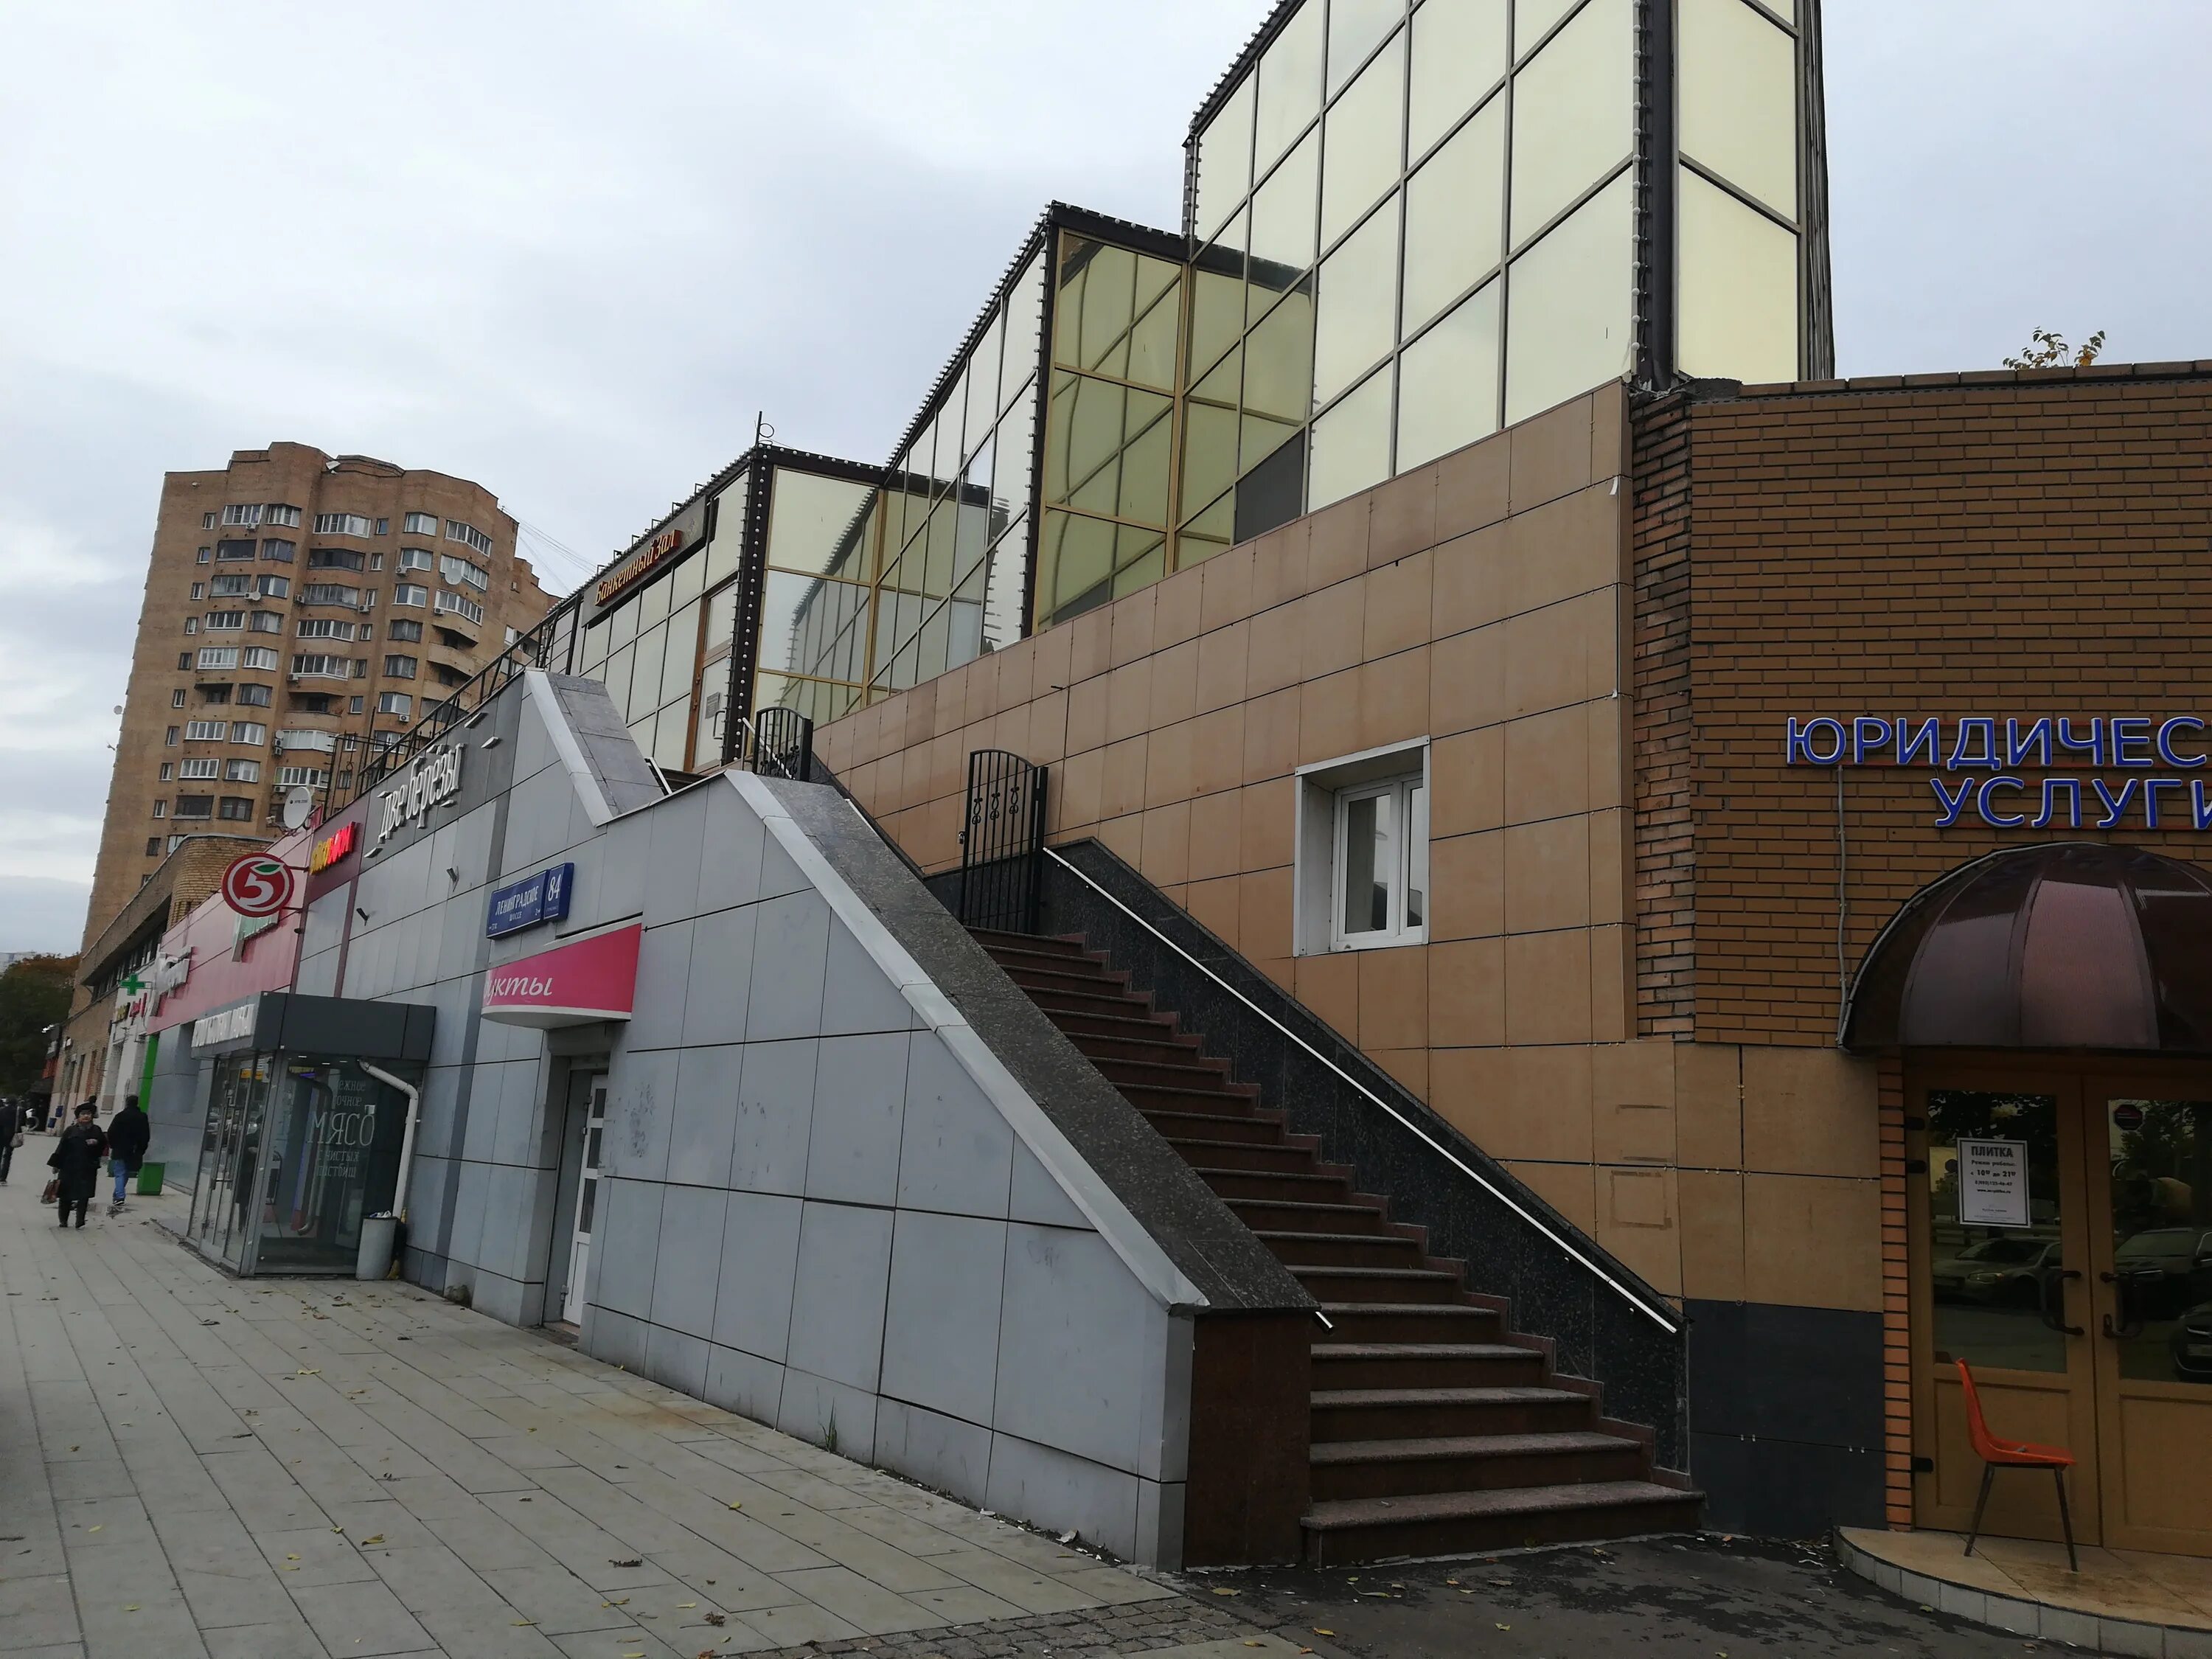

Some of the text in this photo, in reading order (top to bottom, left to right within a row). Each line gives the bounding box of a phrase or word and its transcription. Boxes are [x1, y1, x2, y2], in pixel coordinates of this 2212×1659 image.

[594, 539, 655, 606] Банкетный
[1787, 716, 2212, 772] ЮРИДИЧЕС
[547, 874, 561, 902] 84
[307, 1110, 375, 1147] МЯСО
[1971, 1146, 2014, 1157] ПЛИТКА
